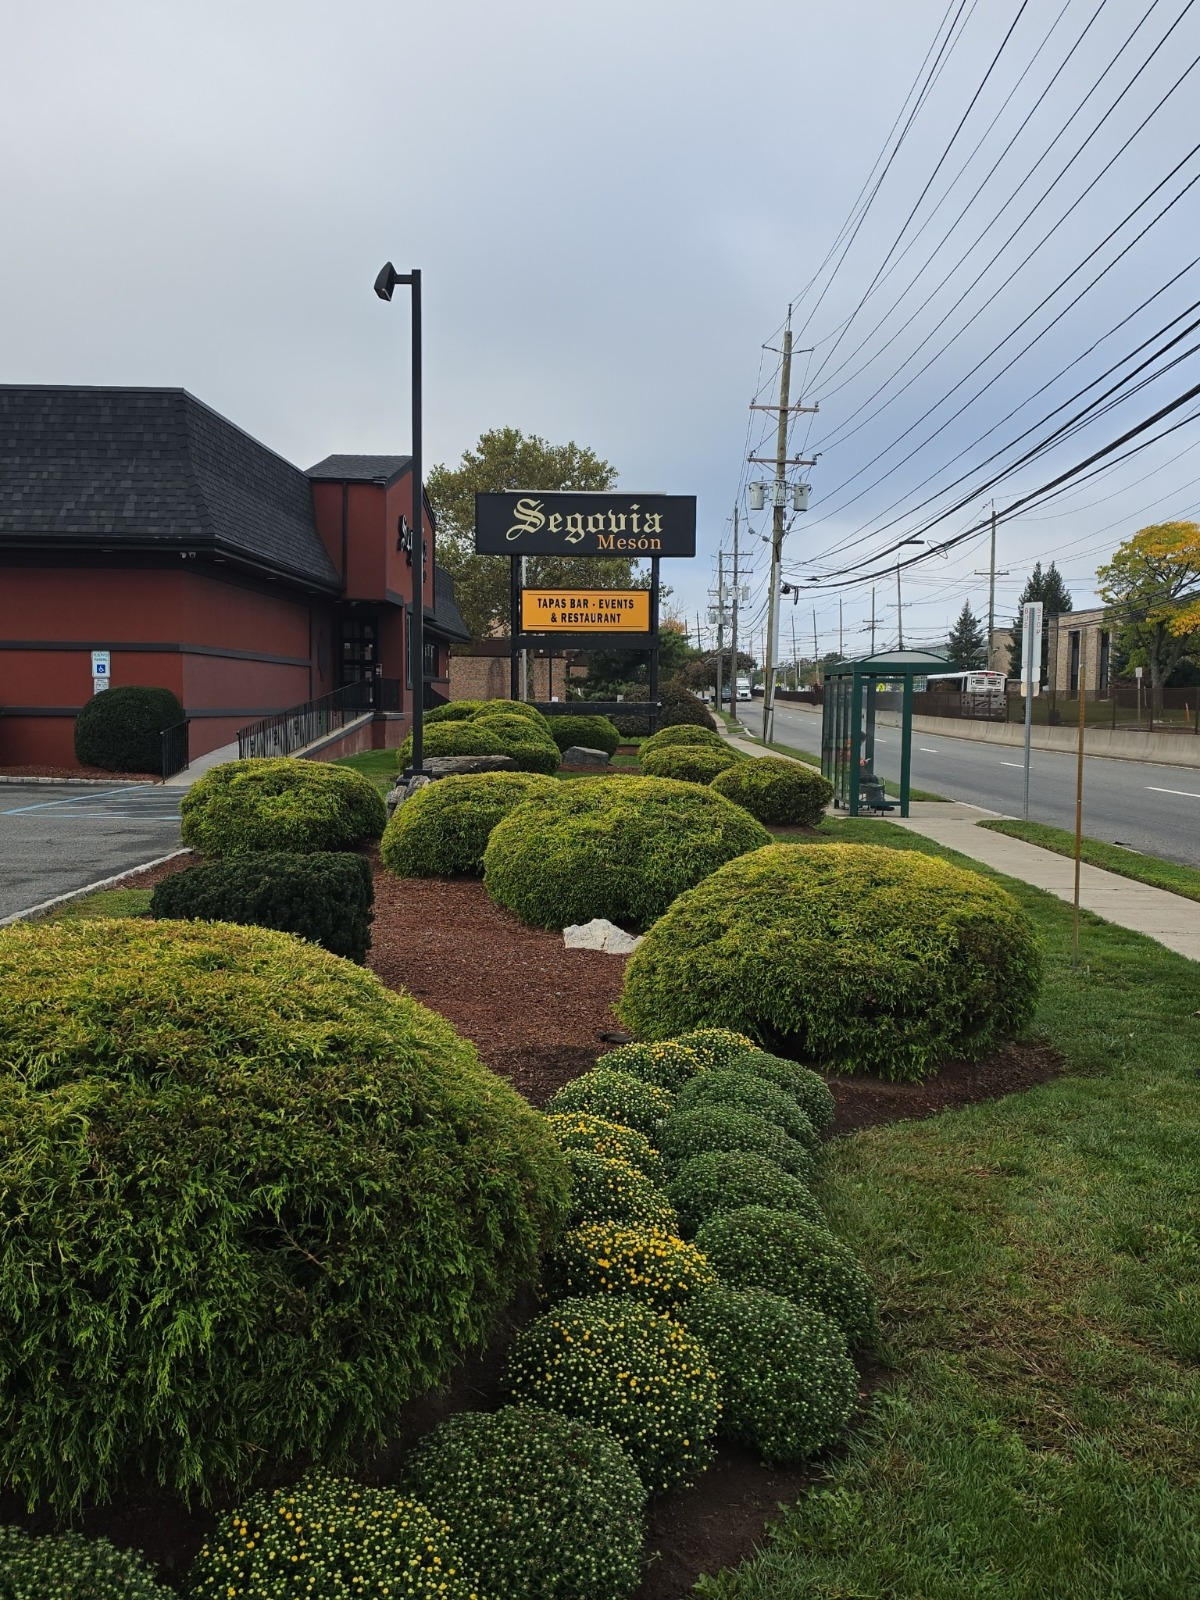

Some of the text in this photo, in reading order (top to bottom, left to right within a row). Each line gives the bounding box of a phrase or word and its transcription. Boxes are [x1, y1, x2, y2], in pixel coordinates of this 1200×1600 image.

[506, 498, 664, 544] Segovia
[597, 534, 662, 550] Mesón
[537, 598, 634, 609] TAPAS BAR EVENTS
[550, 612, 622, 624] & RESTAURANT
